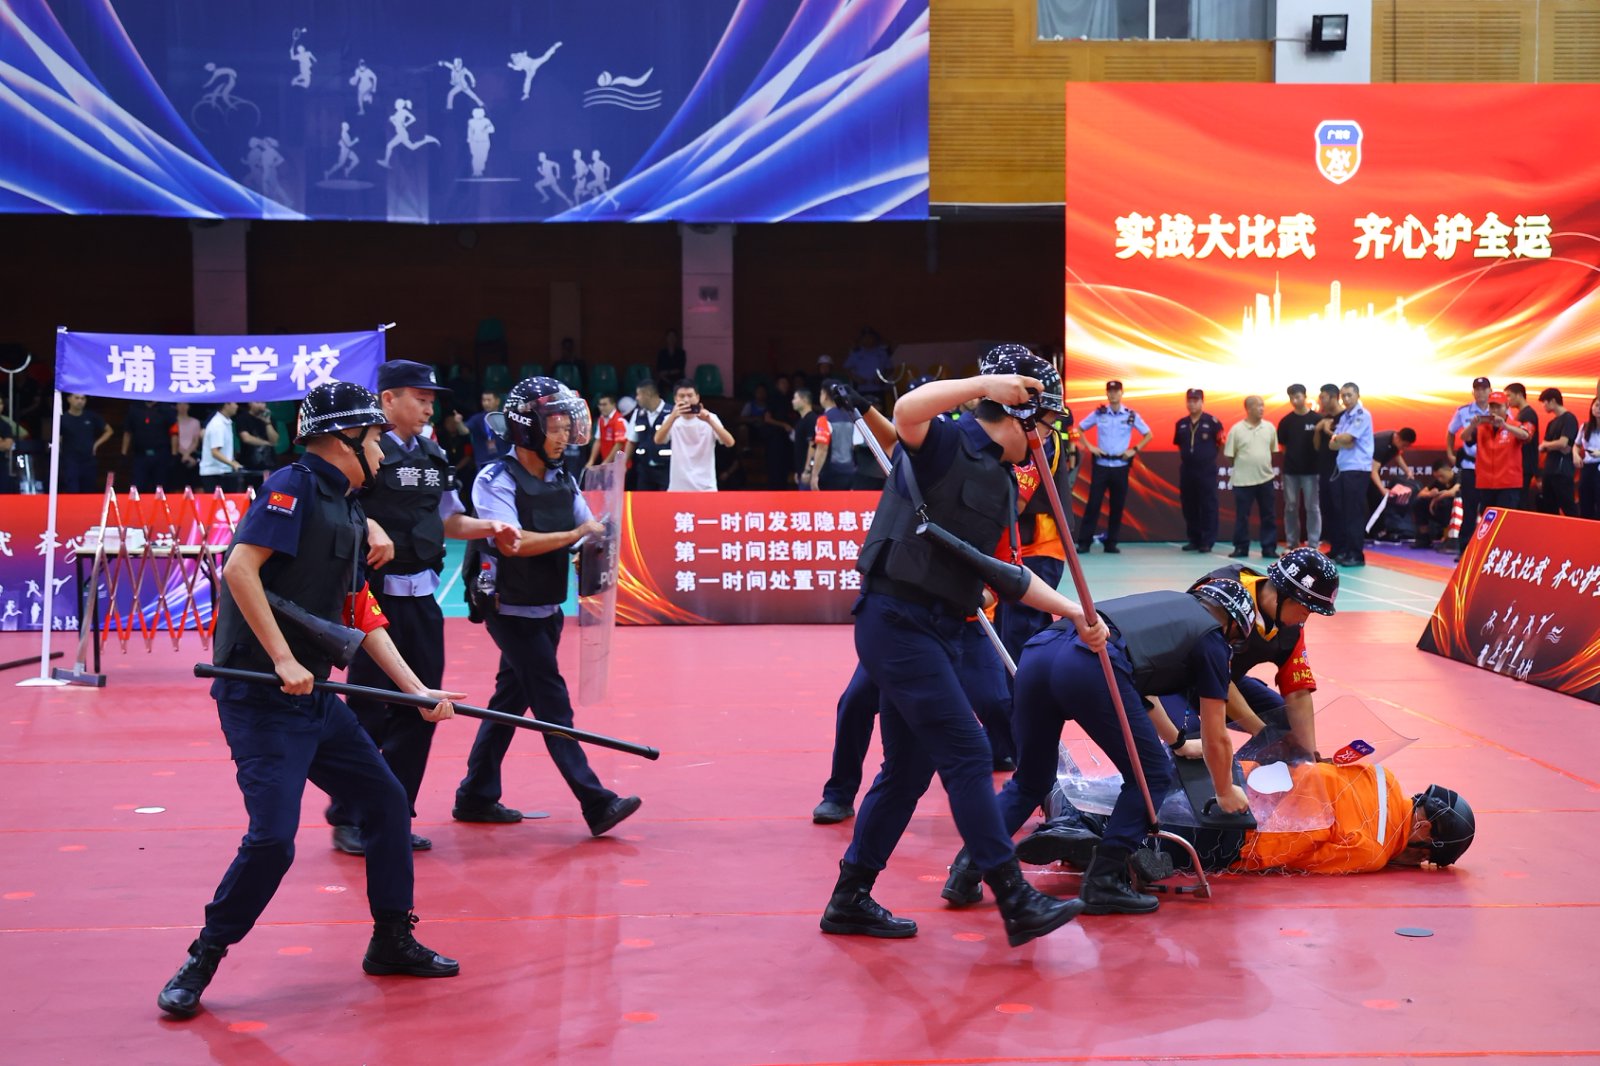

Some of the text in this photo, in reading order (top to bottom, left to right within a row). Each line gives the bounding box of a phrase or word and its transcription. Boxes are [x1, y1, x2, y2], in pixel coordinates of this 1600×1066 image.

[1115, 212, 1552, 260] 实战大比武 齐心护全运
[106, 344, 340, 393] 埔惠学校
[507, 410, 532, 427] POLICE
[396, 466, 441, 487] 警察
[674, 540, 864, 563] 第一时间控制风险
[1481, 547, 1551, 586] 实战大比武
[675, 569, 861, 592] 第一时间处置可控
